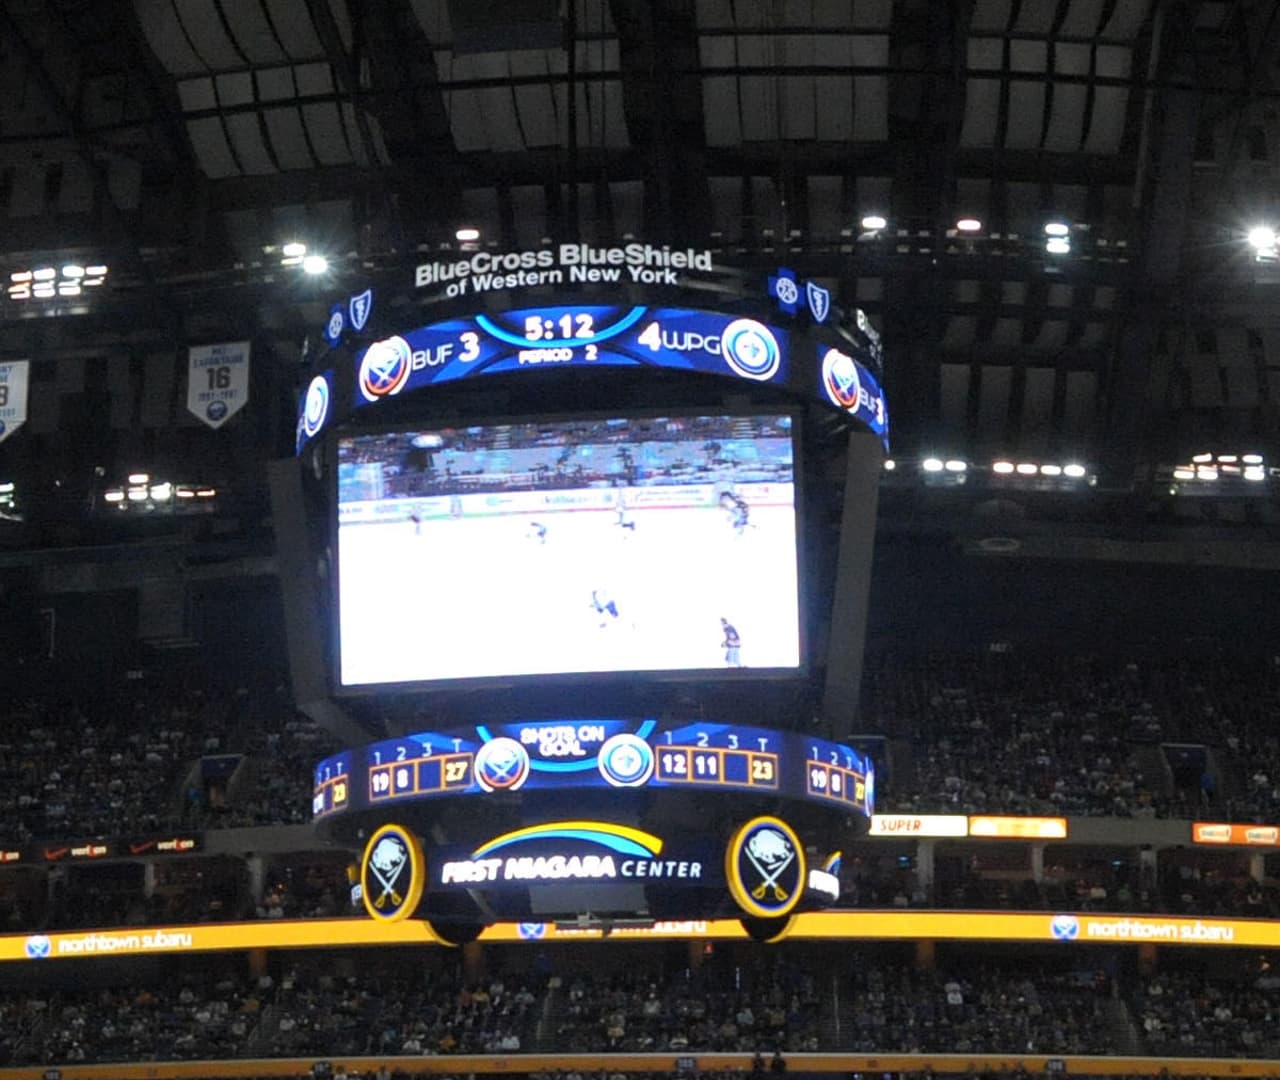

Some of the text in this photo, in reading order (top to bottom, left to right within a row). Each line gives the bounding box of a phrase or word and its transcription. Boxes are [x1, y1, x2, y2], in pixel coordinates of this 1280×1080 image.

[415, 244, 712, 287] BlueCross BlueShield
[446, 266, 677, 298] of Western New York
[524, 314, 595, 341] 5:12
[637, 322, 662, 351] 4
[459, 331, 481, 361] 3
[585, 344, 598, 361] 2
[662, 330, 721, 355] WPG
[411, 342, 453, 371] BUF
[206, 366, 231, 390] 16
[578, 726, 604, 741] ON
[697, 732, 709, 747] 2
[728, 735, 739, 749] 3
[397, 747, 407, 761] 2
[422, 743, 433, 758] 3
[539, 740, 585, 756] GOAL
[662, 754, 773, 780] 12 11 23
[372, 773, 390, 793] 19
[880, 819, 922, 832] SUPER
[71, 843, 107, 857] verizon
[158, 838, 194, 853] verizon
[442, 859, 502, 883] FIRST
[621, 860, 701, 877] CENTER
[58, 929, 192, 953] northtown subaru
[1087, 921, 1234, 941] northtown subaru
